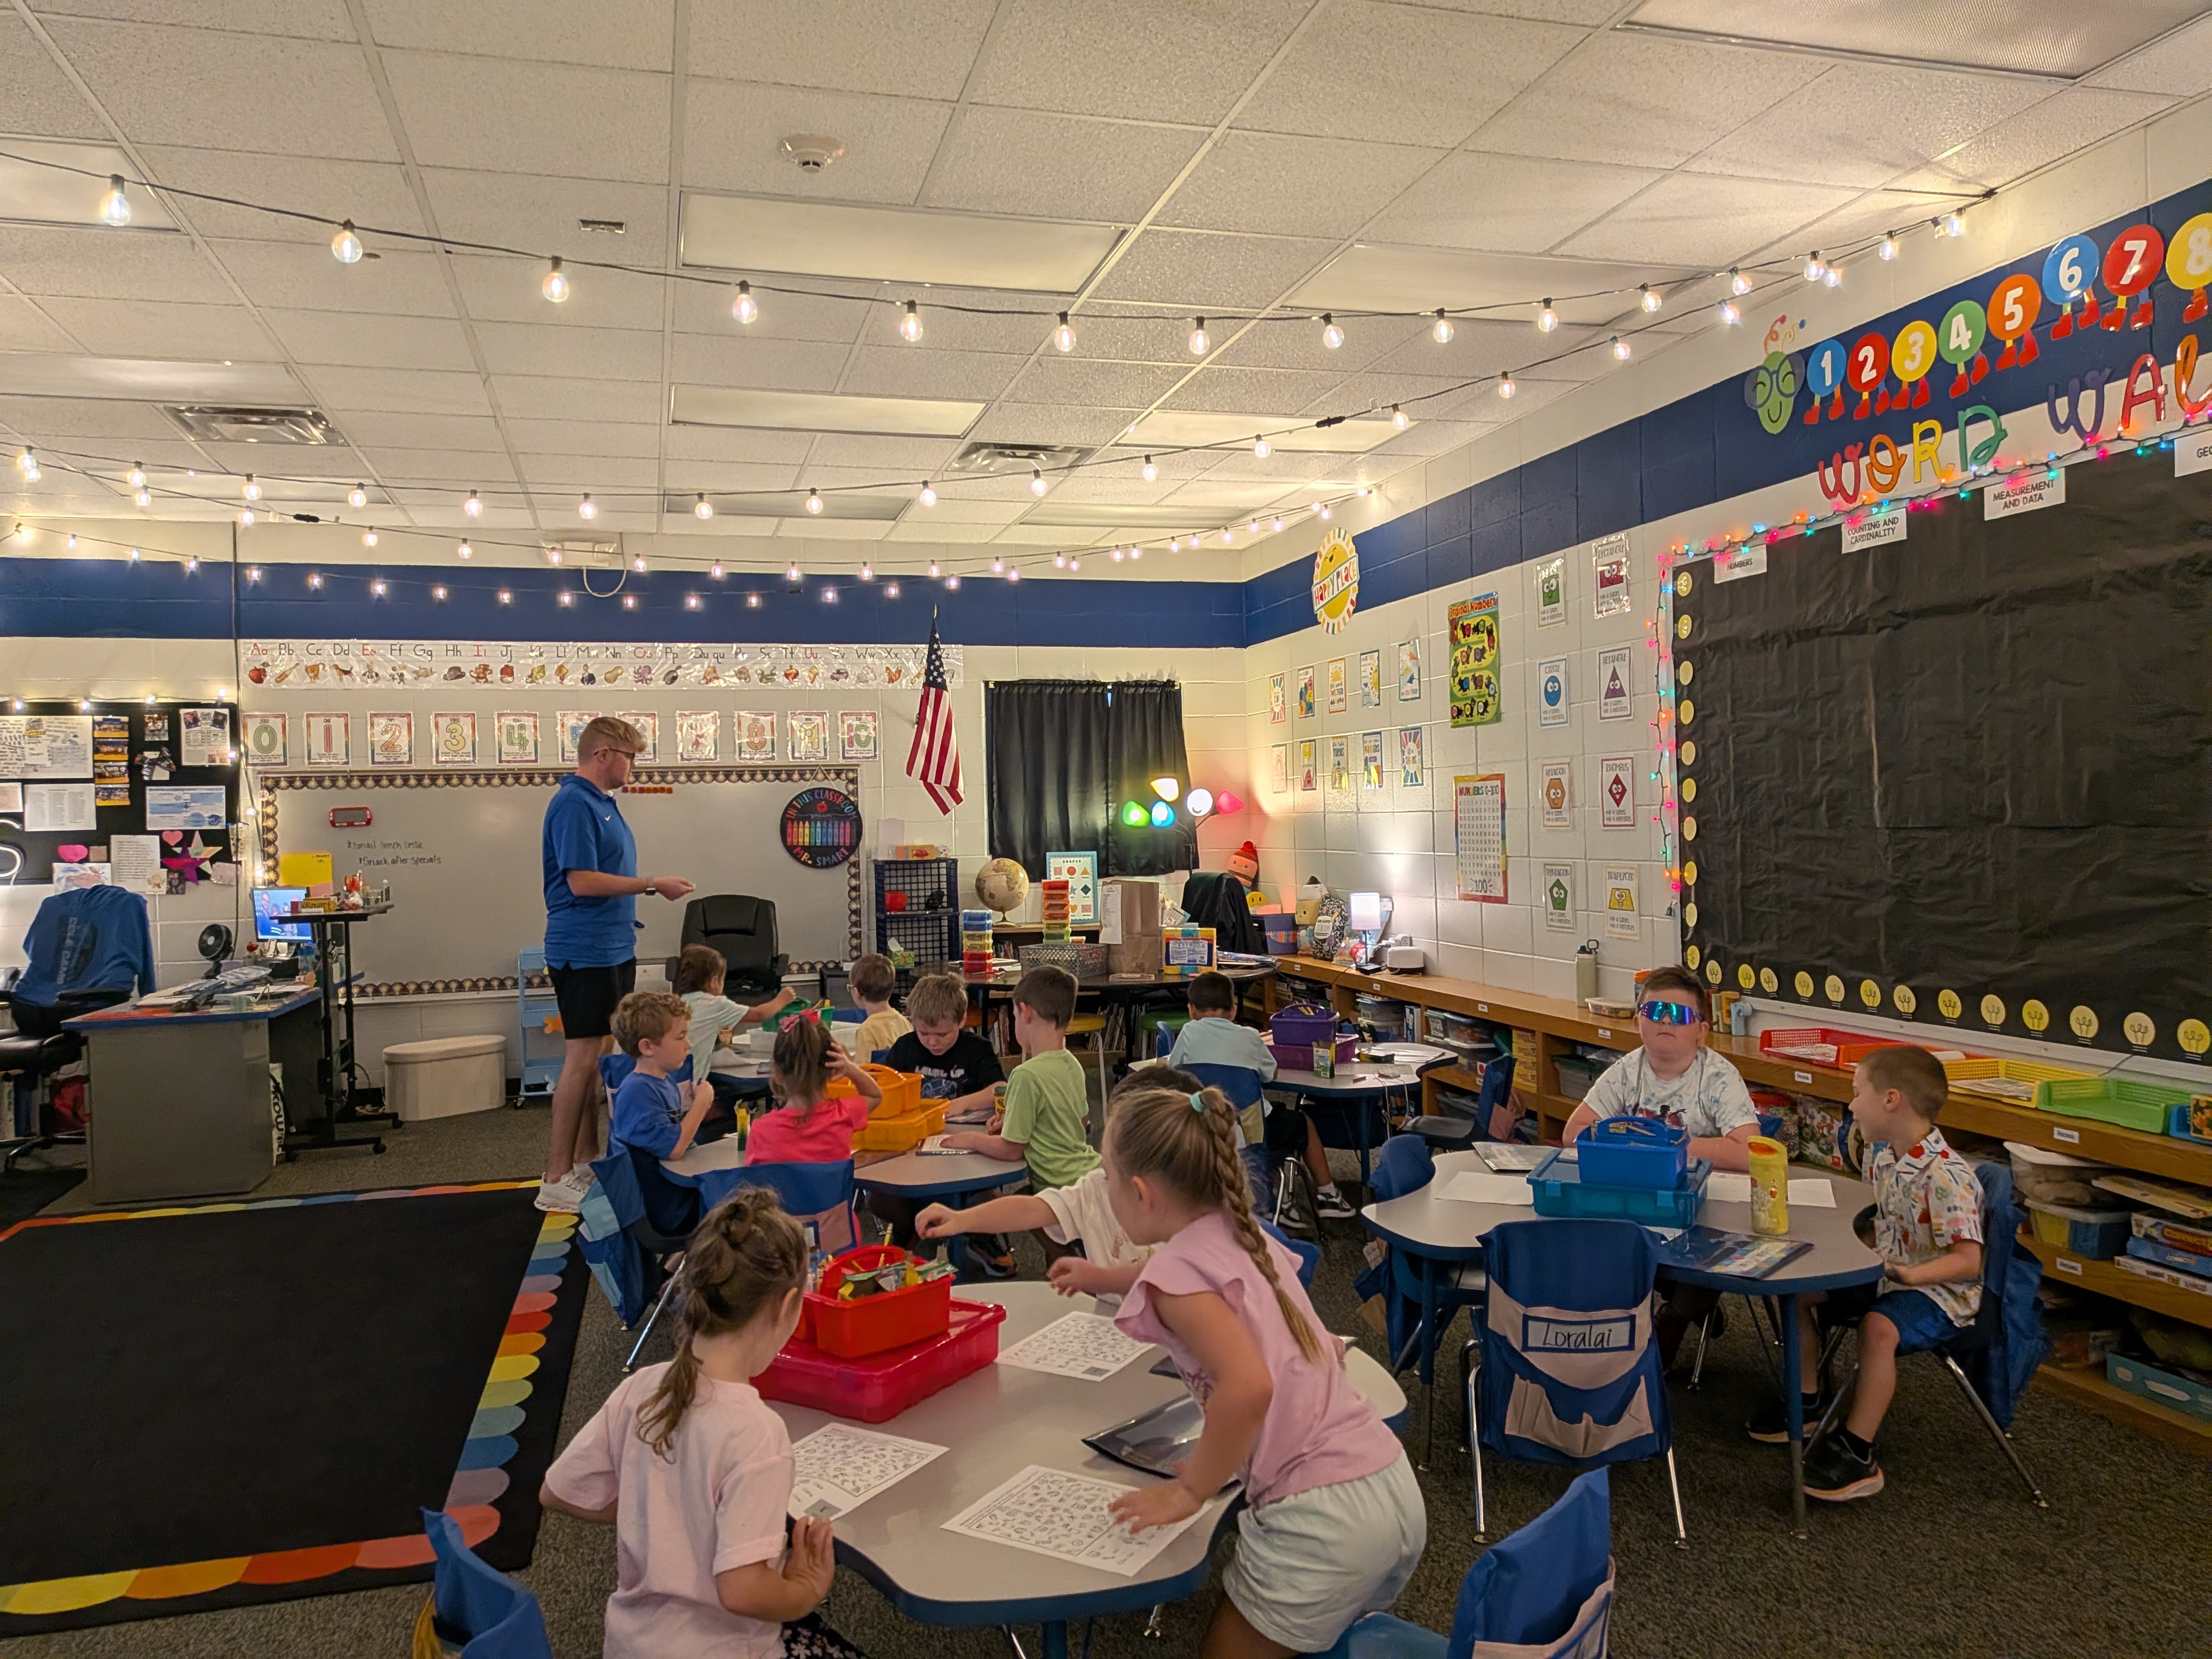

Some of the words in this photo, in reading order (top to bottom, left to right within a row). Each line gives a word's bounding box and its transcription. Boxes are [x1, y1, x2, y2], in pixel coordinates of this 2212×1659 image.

[1821, 351, 1832, 386] 1
[1858, 346, 1876, 383] 2
[1905, 332, 1924, 371] 3
[1949, 314, 1972, 351] 4
[2004, 286, 2023, 331] 5
[2059, 247, 2082, 291] 6
[2120, 240, 2147, 284] 7
[2186, 227, 2212, 275] 8
[1818, 405, 2008, 504] WORD
[1993, 479, 2054, 502] MEASUREMENT
[2002, 499, 2020, 510] AND
[2023, 493, 2043, 505] DATA
[1848, 520, 1880, 535] COUNTING
[1882, 517, 1898, 527] AND
[1850, 526, 1895, 545] CARDINALITY
[1727, 558, 1752, 571] NUMBERS
[1470, 597, 1496, 612] Numbers
[251, 643, 268, 655] Aa
[279, 643, 294, 655] Bb
[306, 643, 322, 655] Cc
[333, 643, 349, 655] Dd
[362, 644, 376, 656] Ee
[390, 643, 403, 656] Ff
[414, 644, 433, 662] Gg
[445, 644, 462, 656] Hh
[473, 644, 486, 656] Ii
[500, 645, 513, 662] Jj
[556, 645, 566, 658] Ll
[606, 646, 621, 659] Nn
[665, 647, 679, 664] Pp
[693, 647, 708, 659] Qu
[712, 651, 725, 664] qu
[759, 648, 771, 659] Ss
[782, 647, 794, 659] Tt
[805, 647, 818, 659] Uu
[855, 648, 876, 659] Ww
[884, 648, 899, 659] Xx
[253, 724, 276, 754] 0
[324, 724, 332, 753] 1
[380, 724, 402, 752] 2
[444, 723, 466, 751] 3
[507, 724, 529, 751] 4
[747, 722, 766, 750] 8
[800, 722, 819, 749] 9
[847, 722, 872, 748] 10
[1459, 786, 1484, 796] NUMBERS
[786, 808, 797, 819] IN
[792, 791, 813, 808] THIS
[815, 790, 858, 820] CLASSROOM
[391, 856, 408, 865] after
[793, 847, 812, 864] MR.
[816, 847, 848, 866] SMART
[1474, 879, 1488, 893] 100
[915, 1065, 947, 1078] LEVEL
[950, 1067, 964, 1078] UP
[1543, 1323, 1612, 1348] Loralai
